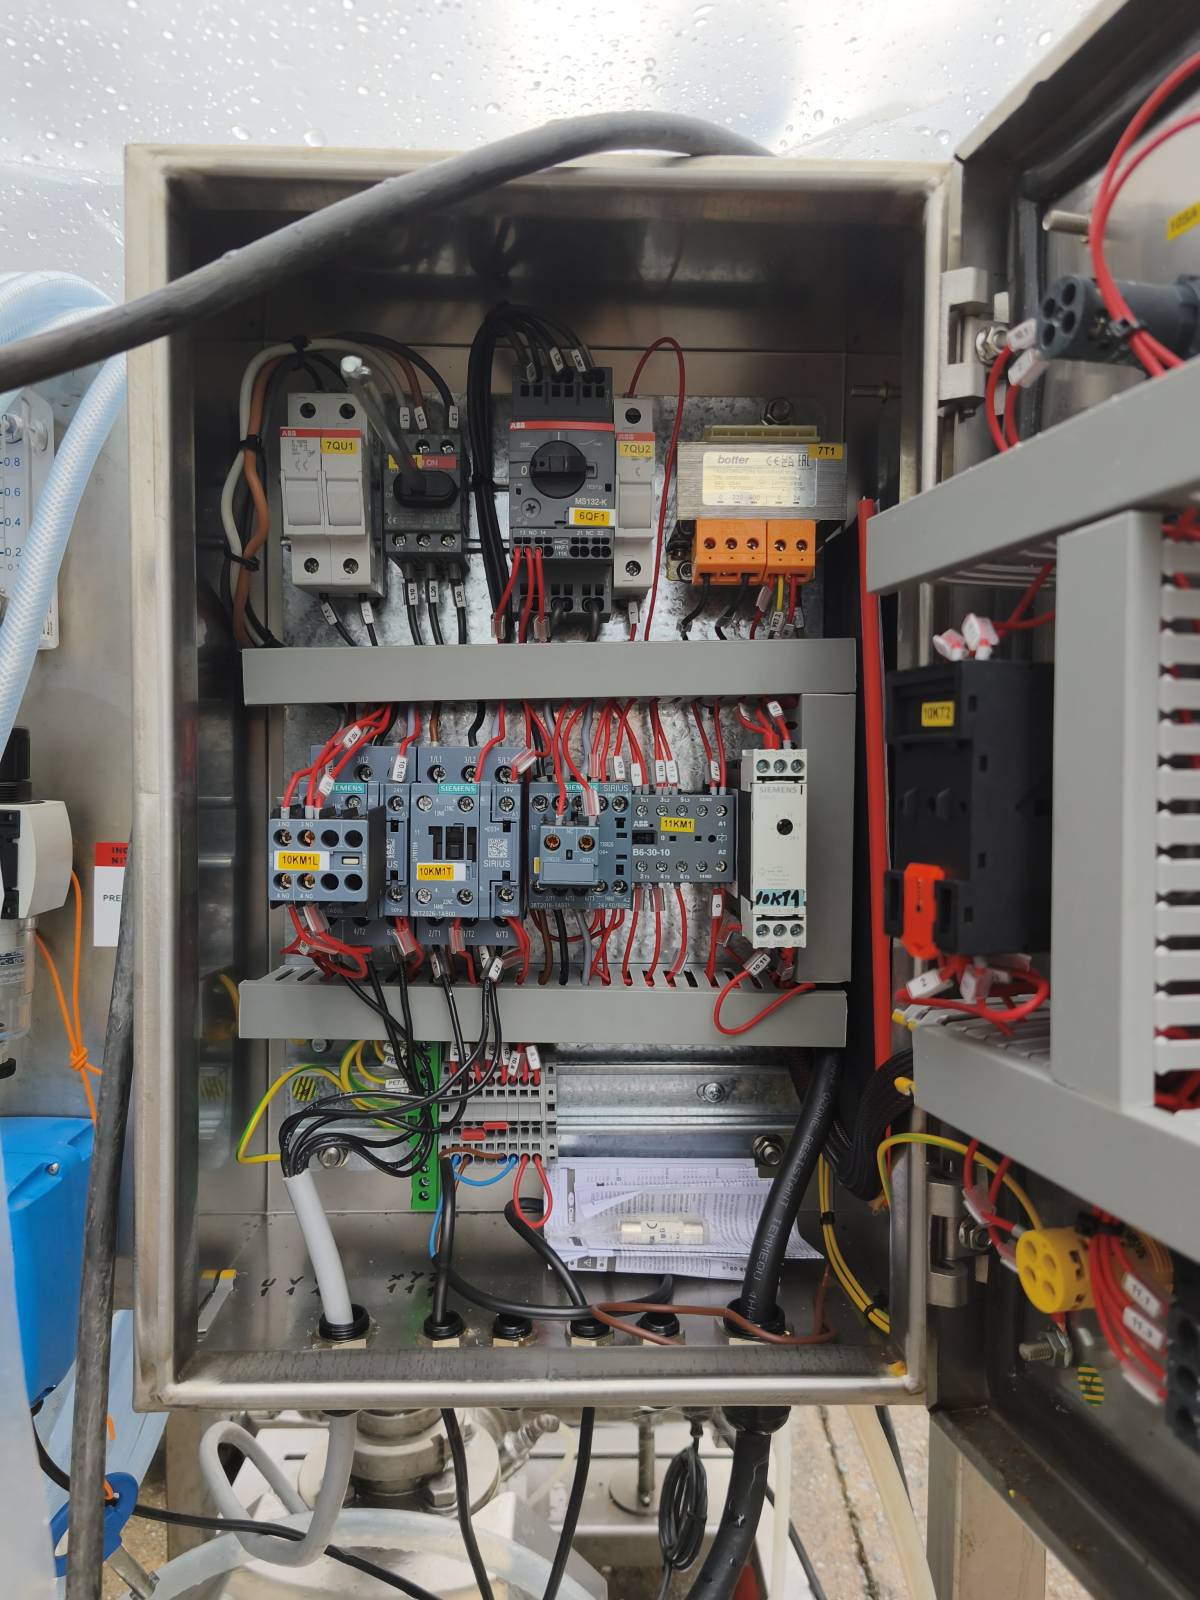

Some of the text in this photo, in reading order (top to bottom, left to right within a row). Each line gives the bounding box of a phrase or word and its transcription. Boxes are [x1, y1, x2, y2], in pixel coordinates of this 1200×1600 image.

[509, 421, 526, 430] ABB
[326, 440, 354, 452] 7QU1
[623, 443, 651, 455] 7QU2
[817, 446, 835, 456] 7T1
[574, 497, 608, 506] MS132-K
[579, 511, 605, 521] 6QF1
[333, 784, 363, 792] IEMENS
[565, 784, 598, 792] SIEMS
[603, 784, 629, 792] SIRIUS
[760, 786, 798, 794] SIEMENS
[633, 820, 649, 828] ABB
[663, 819, 692, 829] 11KM1
[632, 848, 671, 857] B6-30-10
[282, 855, 319, 866] 10KM1L
[483, 859, 511, 868] SIRIUS
[419, 867, 452, 876] 10KM1T
[752, 956, 769, 972] 10.11
